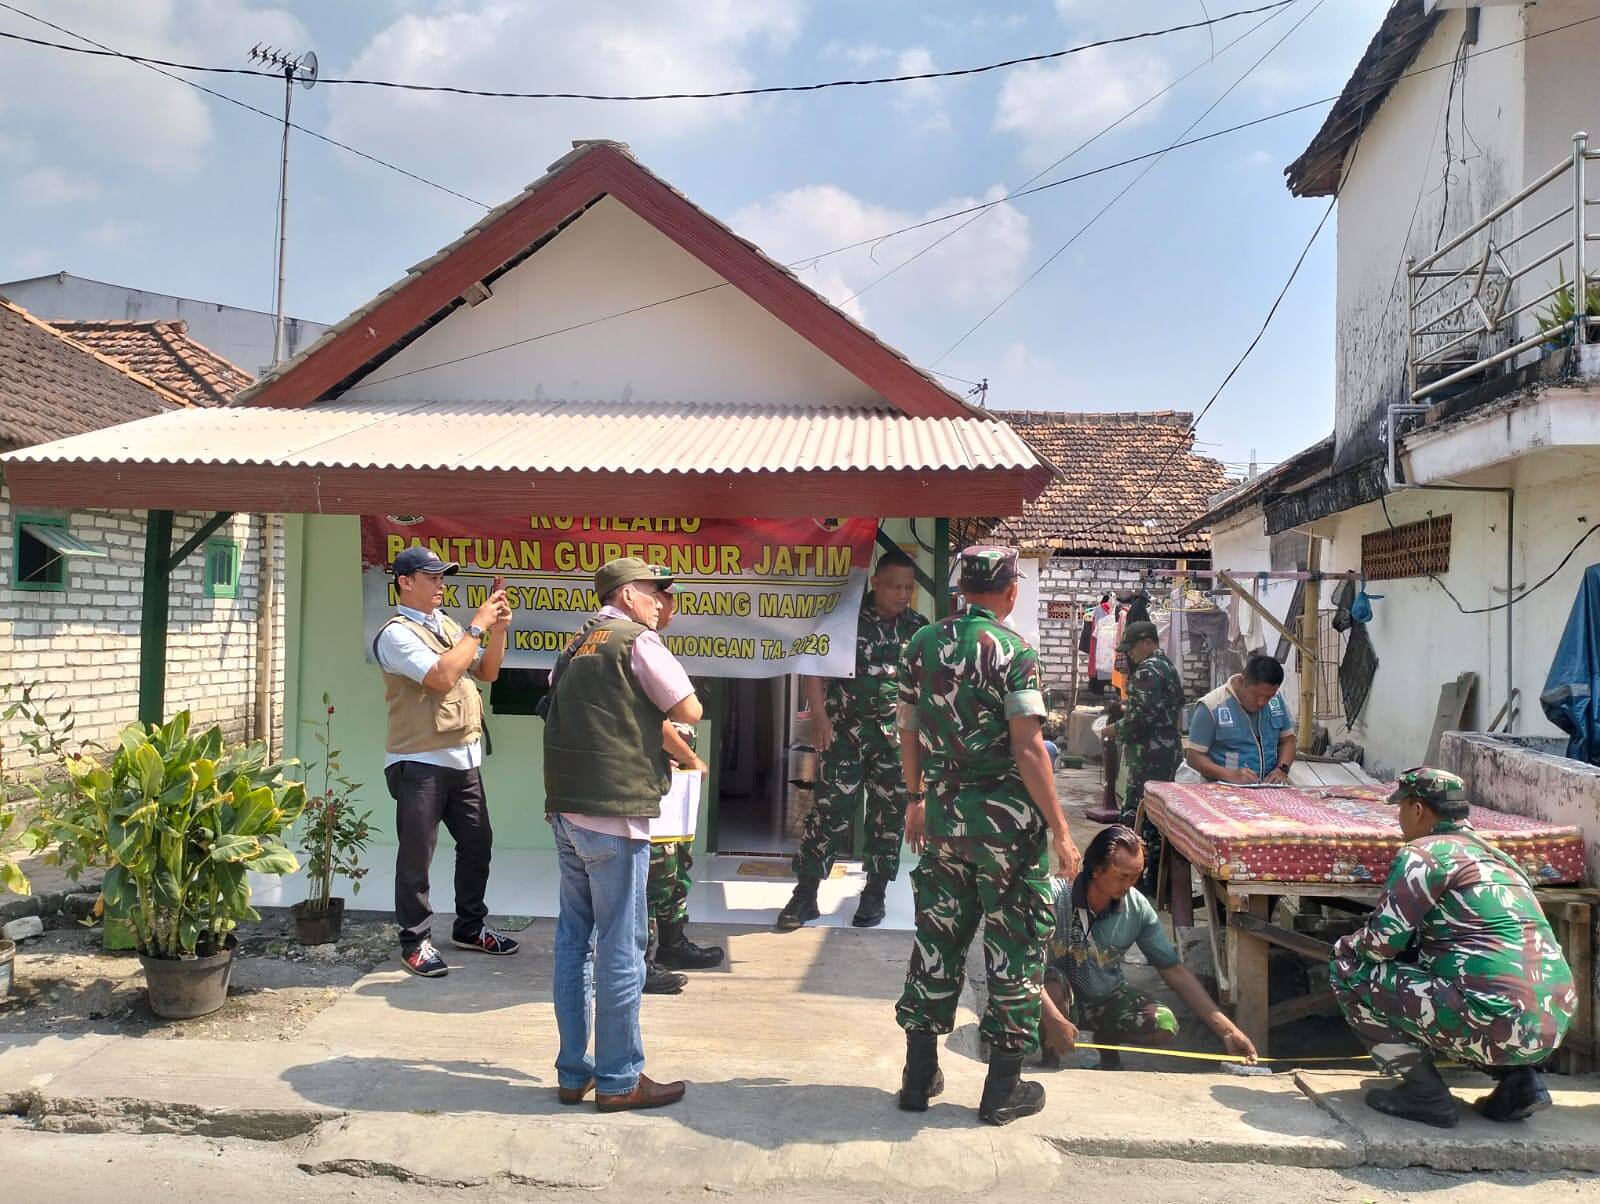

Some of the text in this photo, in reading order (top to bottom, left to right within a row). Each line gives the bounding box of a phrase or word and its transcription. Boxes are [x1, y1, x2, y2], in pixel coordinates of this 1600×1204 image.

[754, 544, 851, 577] JATIM
[758, 592, 842, 619] MAMPU
[514, 629, 575, 651] KODI
[760, 639, 787, 660] TA.
